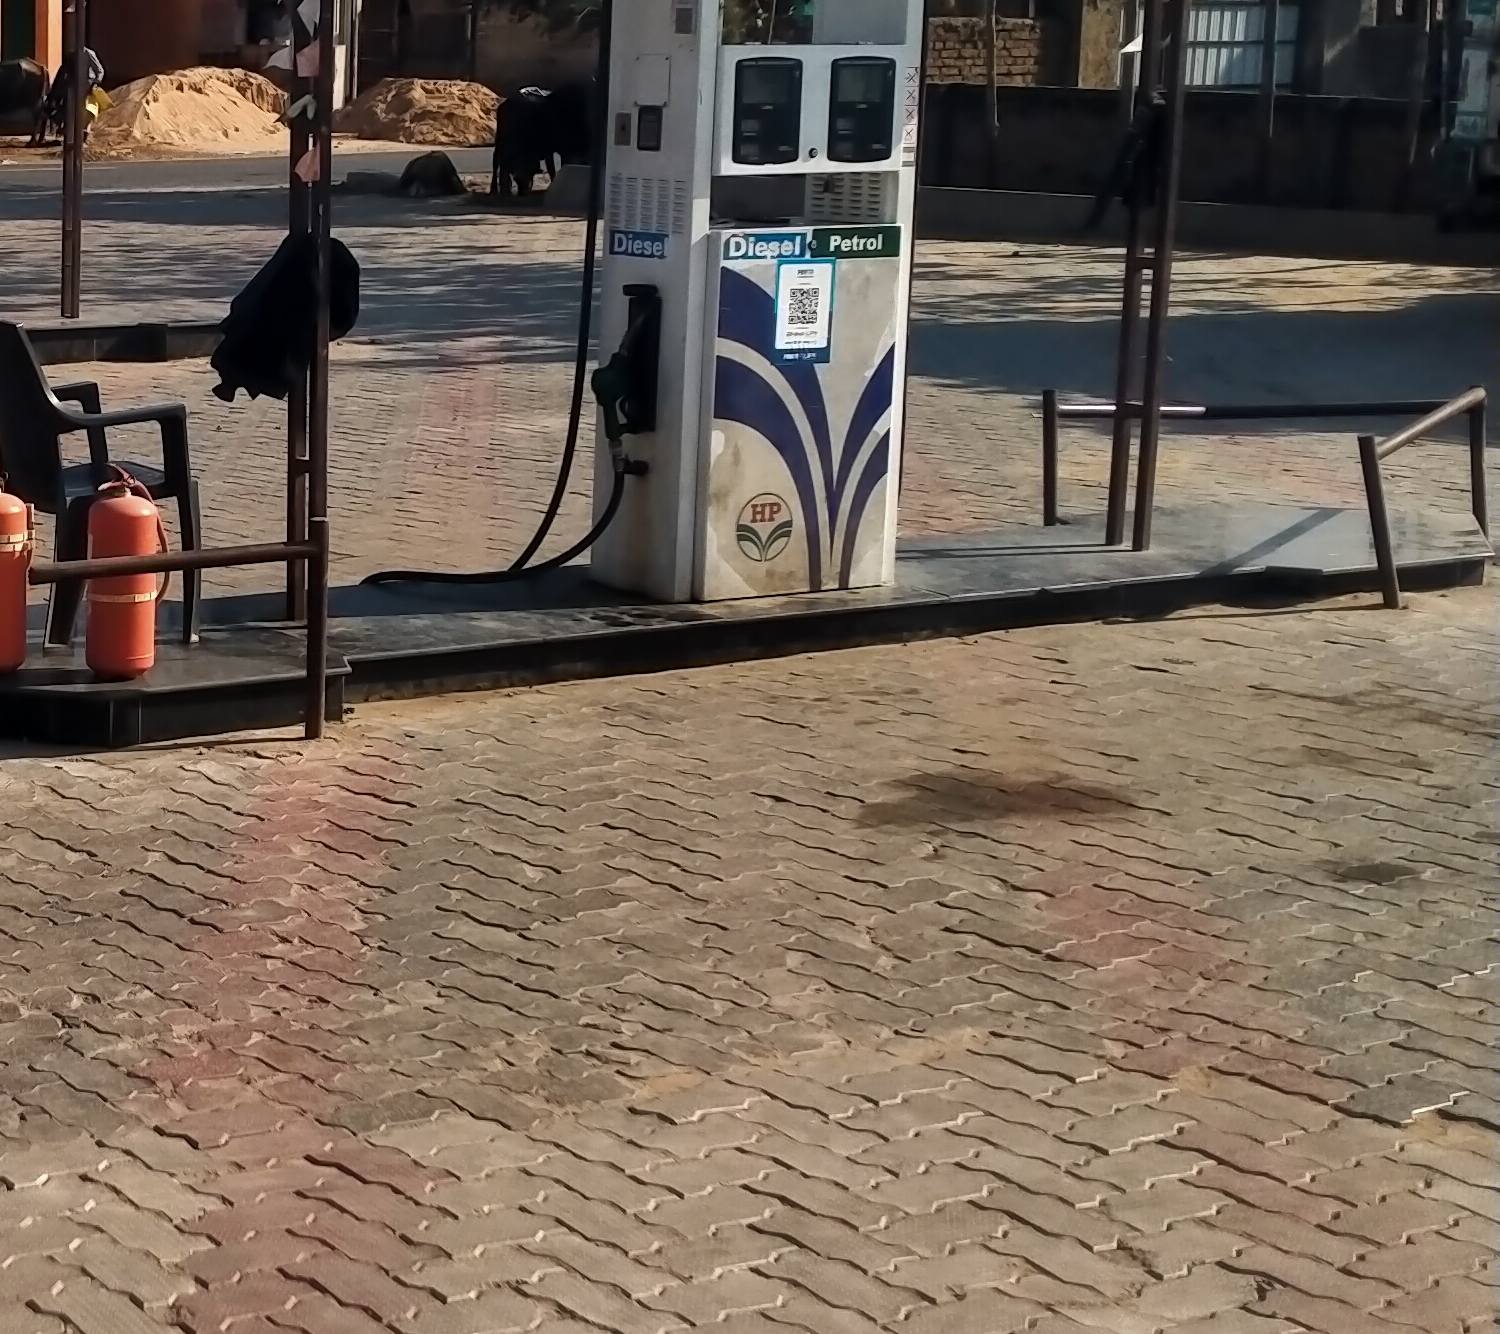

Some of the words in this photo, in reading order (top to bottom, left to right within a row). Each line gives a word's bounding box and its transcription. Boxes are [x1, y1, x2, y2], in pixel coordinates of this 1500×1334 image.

[613, 233, 669, 258] Diesel
[728, 236, 802, 259] Diesel
[828, 233, 884, 252] Petrol
[749, 501, 782, 523] HP
